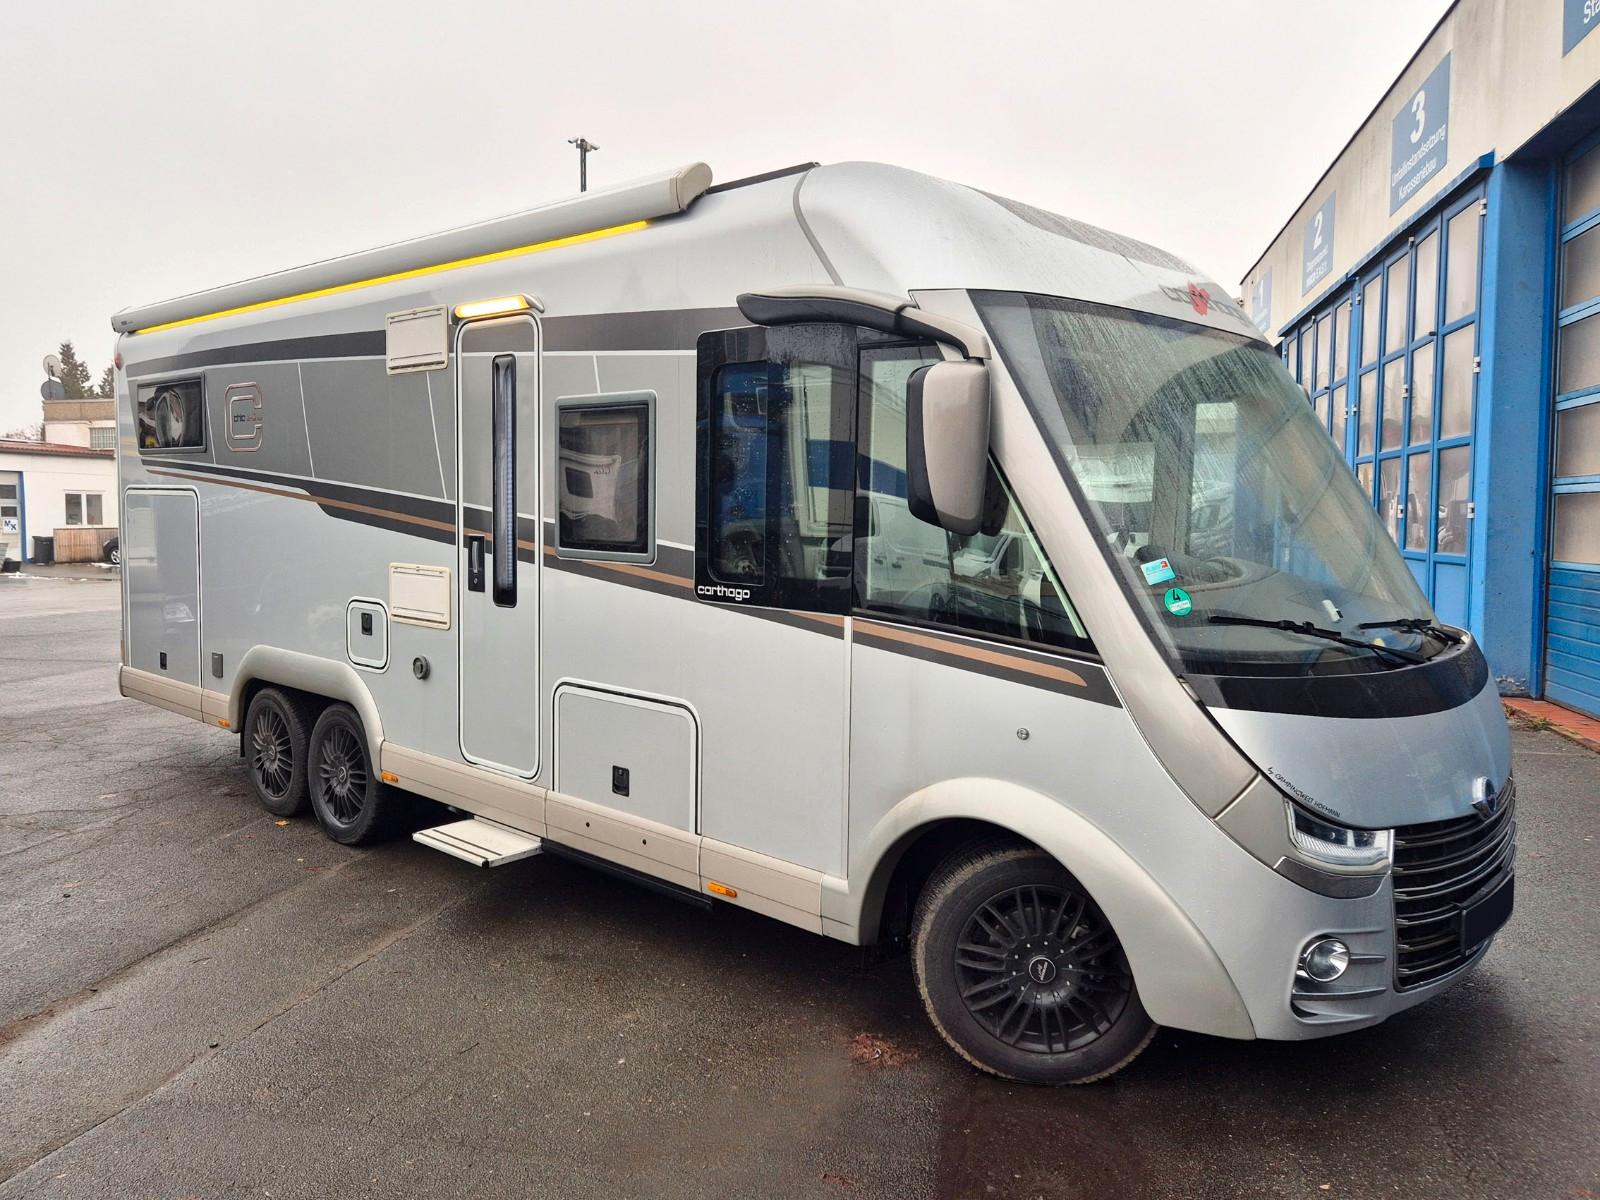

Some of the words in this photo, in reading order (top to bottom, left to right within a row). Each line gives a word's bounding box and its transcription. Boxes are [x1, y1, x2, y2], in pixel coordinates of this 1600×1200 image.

[1410, 90, 1426, 144] 3
[1313, 210, 1324, 250] 2
[697, 585, 751, 601] carthago
[1172, 589, 1181, 601] 4
